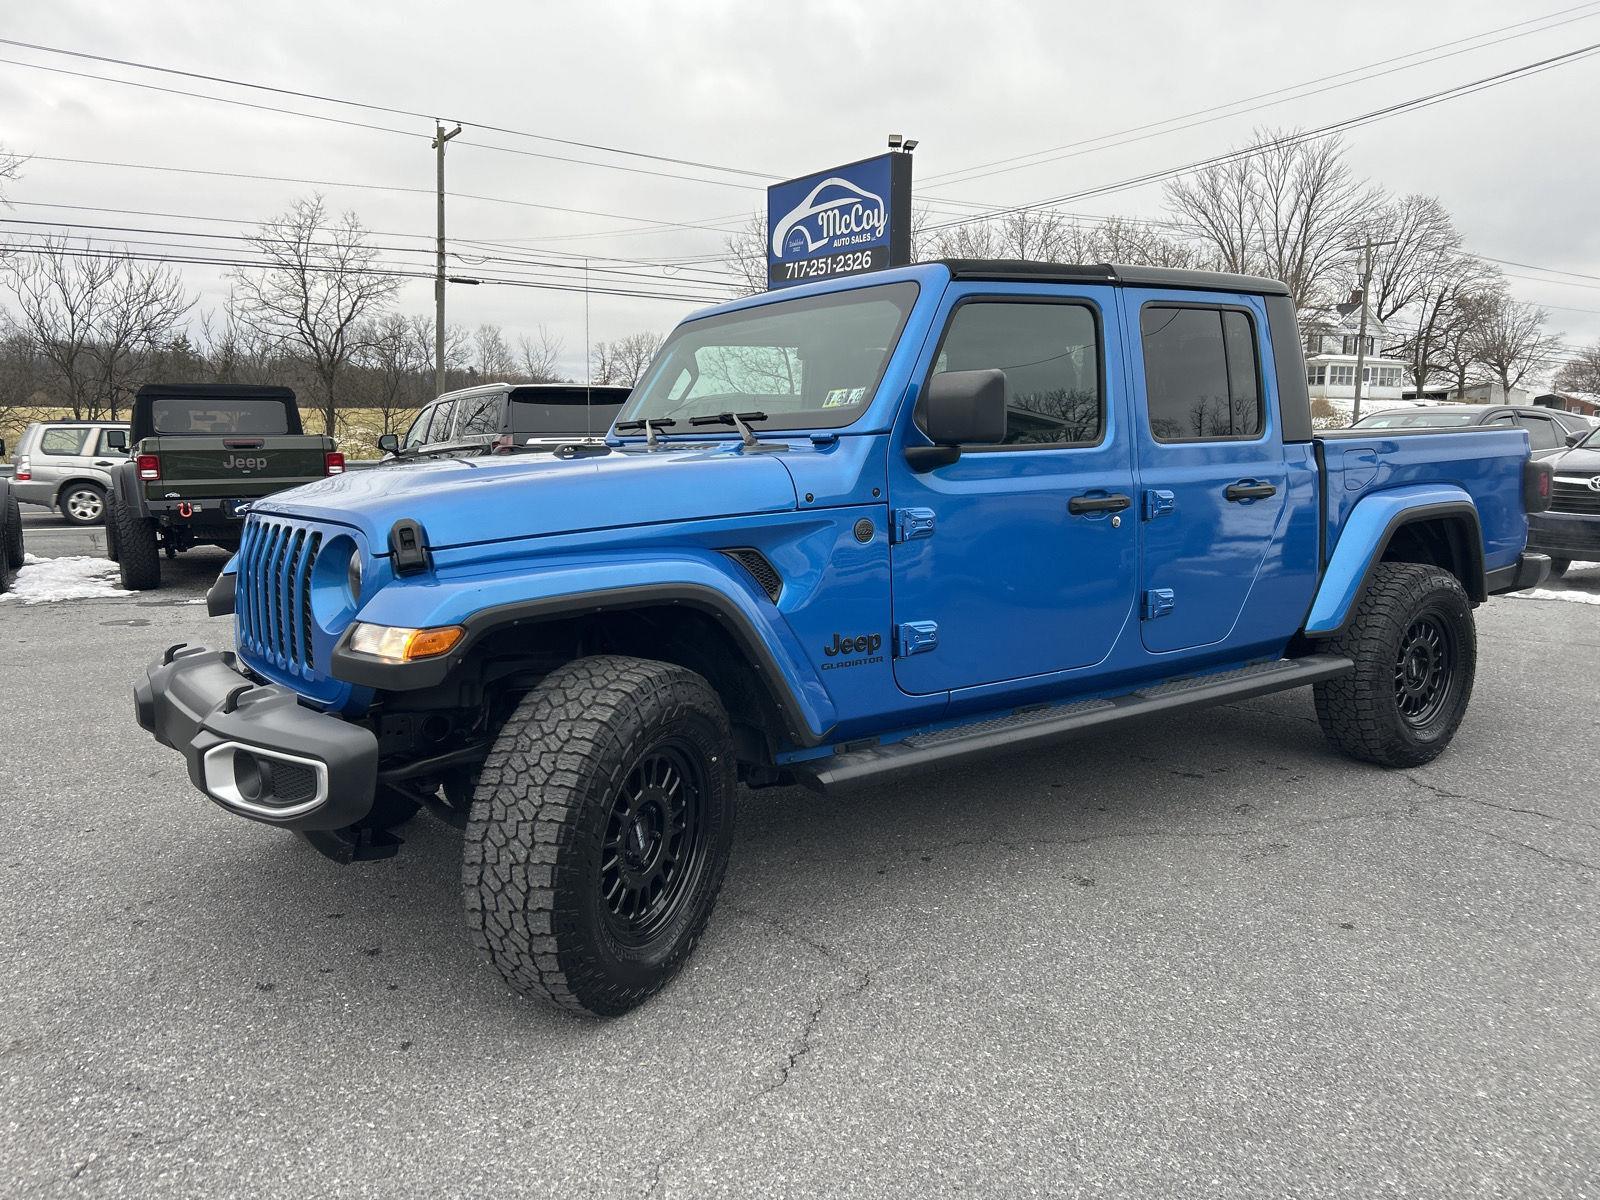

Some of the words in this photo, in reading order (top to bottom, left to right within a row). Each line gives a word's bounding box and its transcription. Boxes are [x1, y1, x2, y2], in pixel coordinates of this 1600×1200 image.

[818, 204, 888, 237] McCoy
[833, 238, 850, 247] AUTO
[851, 233, 871, 244] SALES
[785, 251, 872, 278] 717-251-2326
[223, 454, 267, 470] Jeep
[824, 632, 882, 656] Jeep
[821, 656, 883, 670] GLADIATOR
